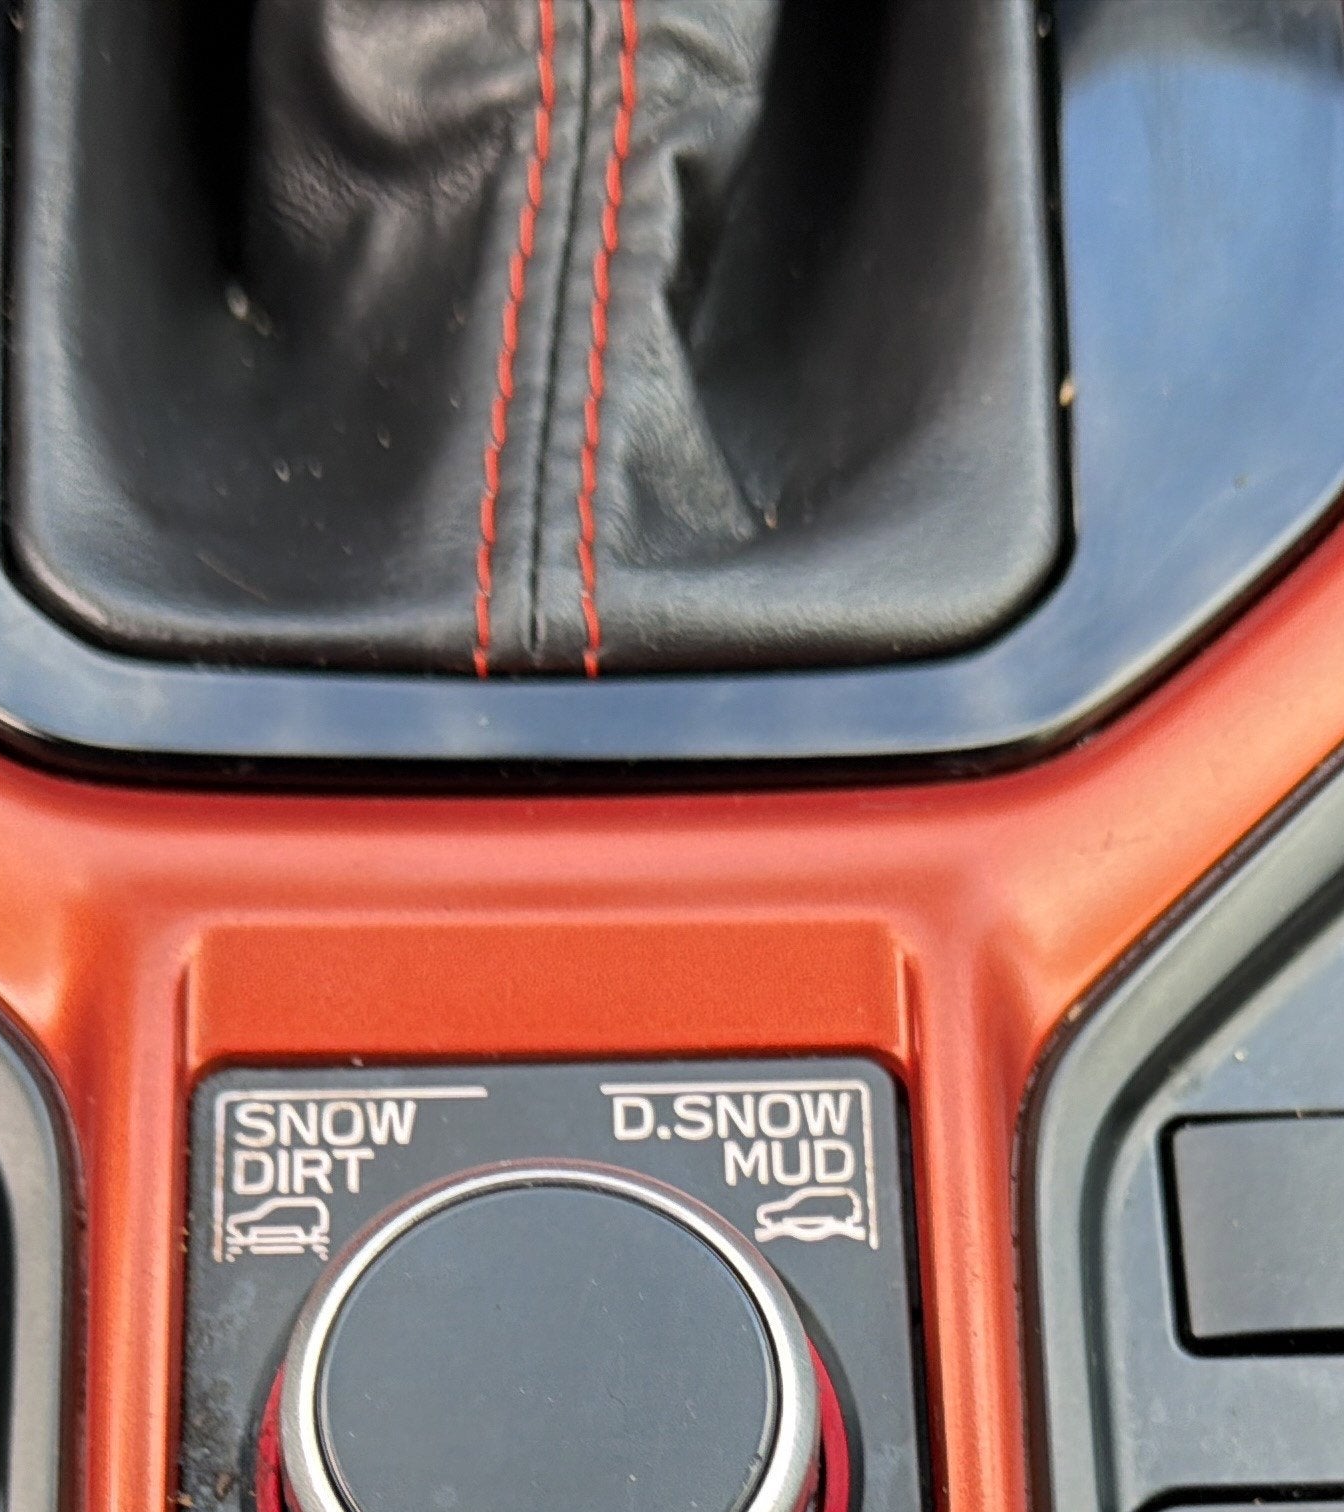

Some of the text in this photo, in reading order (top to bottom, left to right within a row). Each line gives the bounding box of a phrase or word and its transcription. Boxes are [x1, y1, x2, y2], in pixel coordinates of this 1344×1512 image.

[233, 1099, 417, 1147] SNOW
[612, 1090, 853, 1142] D.SNOW
[232, 1147, 375, 1195] DIRT
[723, 1139, 855, 1188] MUD
